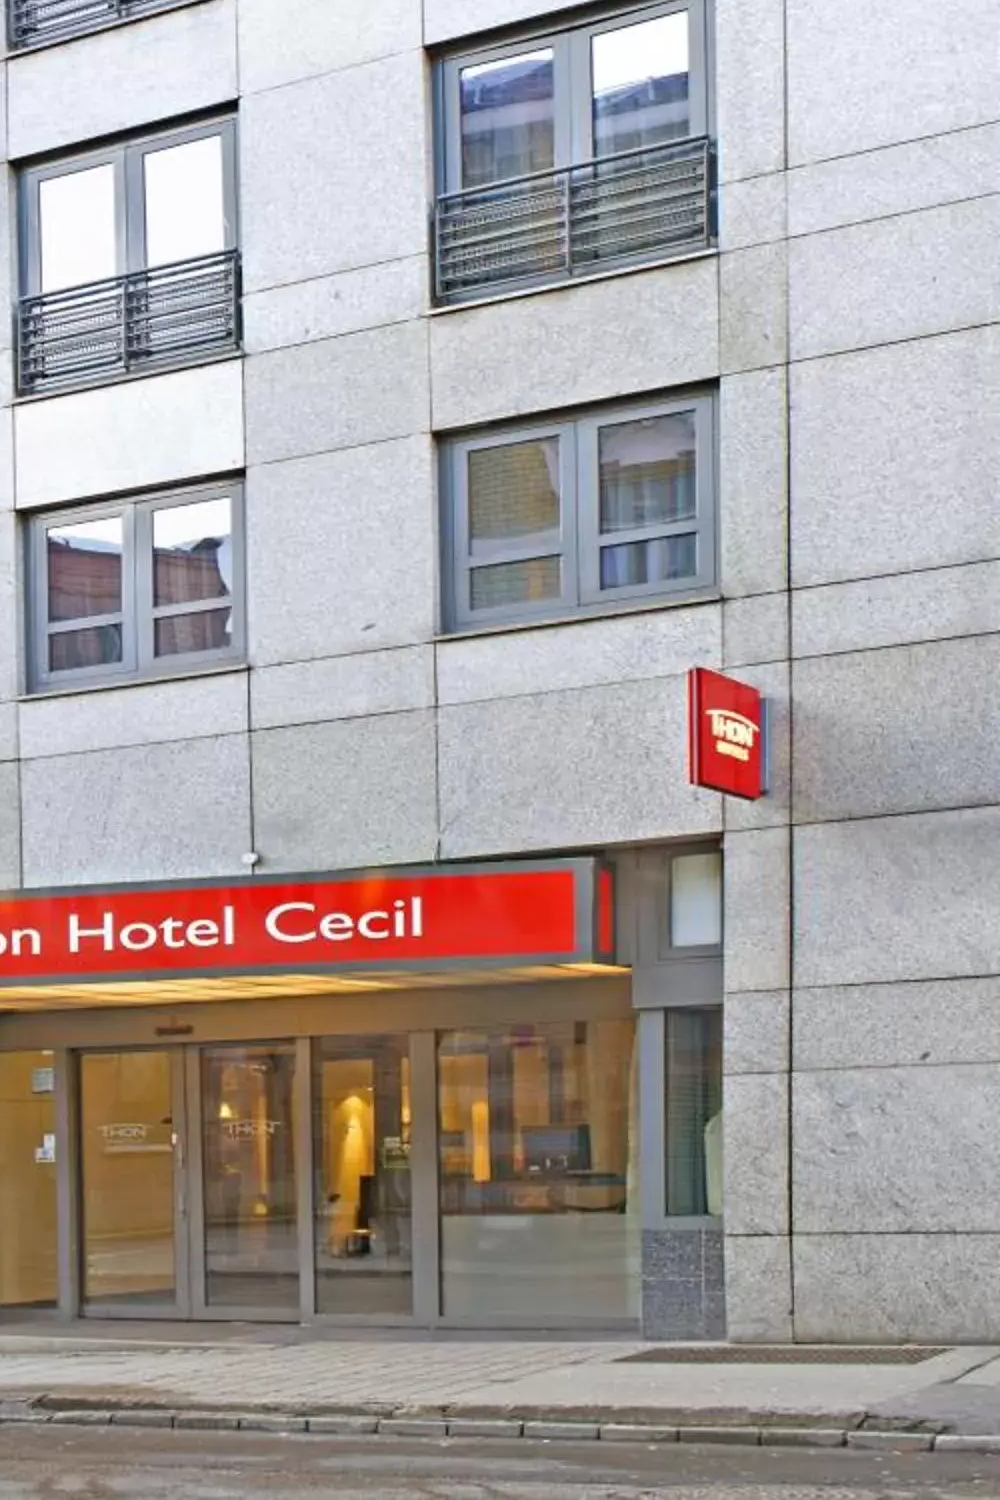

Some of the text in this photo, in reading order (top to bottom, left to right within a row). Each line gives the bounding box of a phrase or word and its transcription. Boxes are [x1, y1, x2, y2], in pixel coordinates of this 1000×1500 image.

[705, 709, 760, 748] THON
[68, 905, 235, 953] Hotel
[265, 896, 424, 944] Cecil
